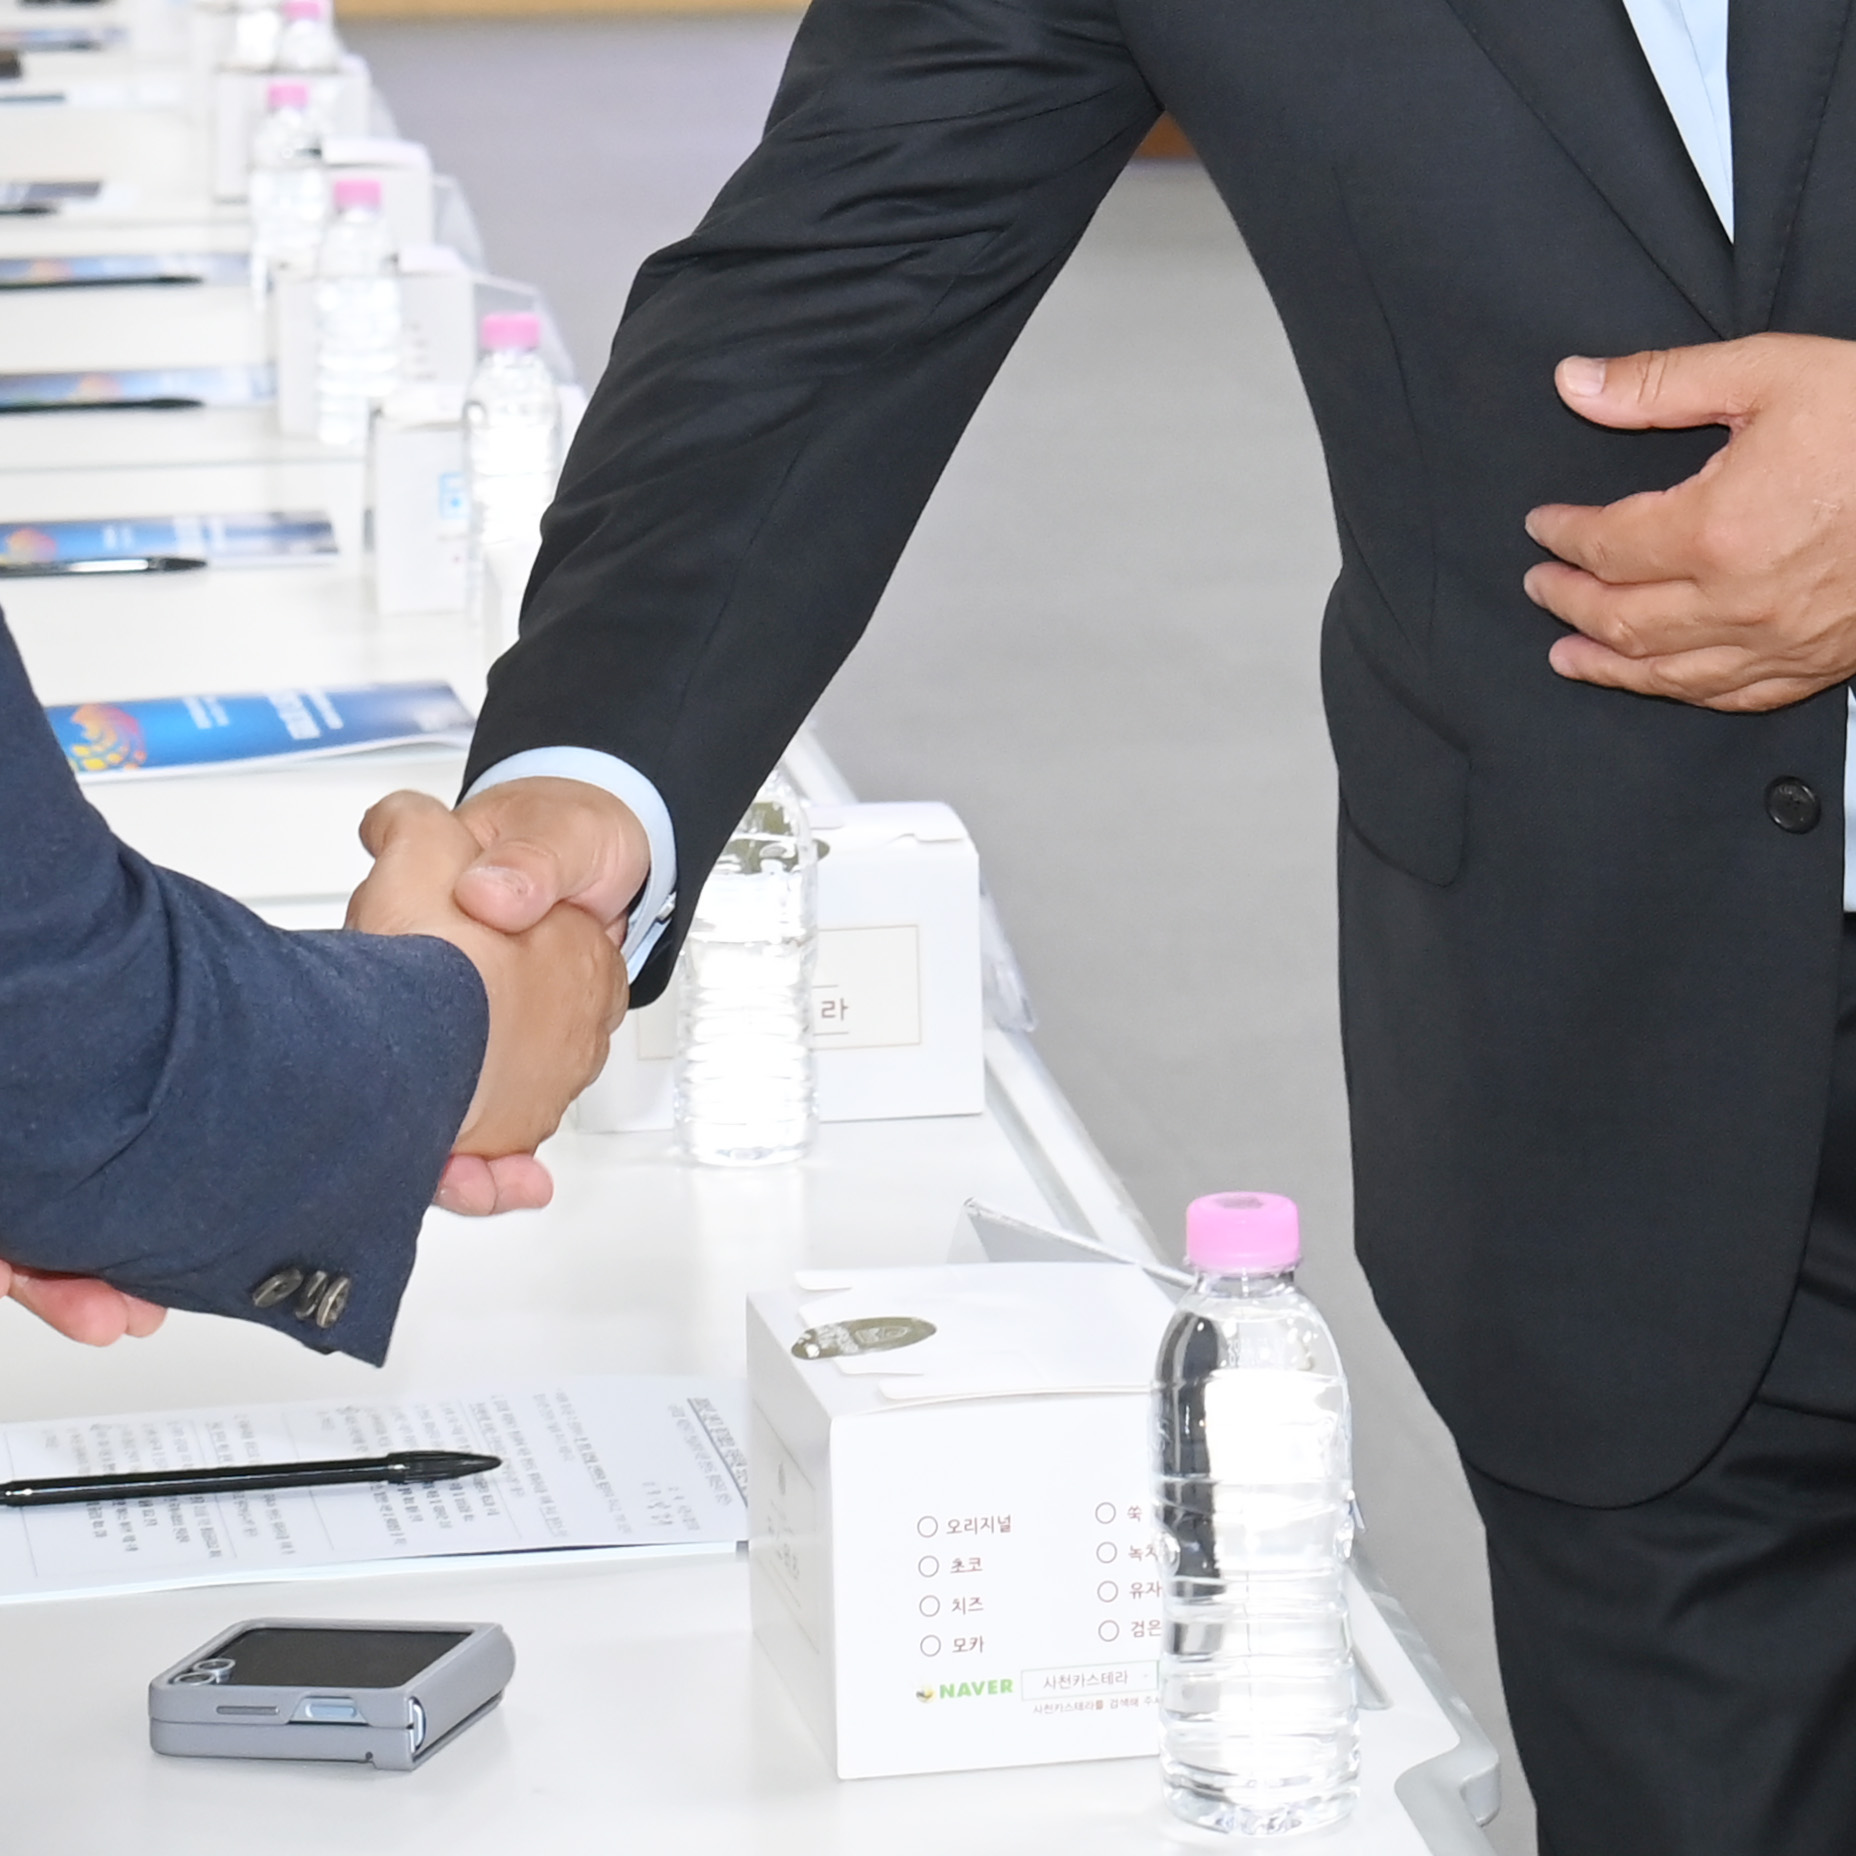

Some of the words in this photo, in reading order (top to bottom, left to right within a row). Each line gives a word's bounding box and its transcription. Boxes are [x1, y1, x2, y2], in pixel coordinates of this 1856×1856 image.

[1127, 1505, 1142, 1522] 쑥
[946, 1514, 1012, 1535] 오리지널
[950, 1556, 983, 1574] 초코
[1130, 1580, 1163, 1600] 유자
[951, 1596, 984, 1615] 치즈
[952, 1636, 984, 1653] 모카
[939, 1678, 1013, 1699] NAVER
[1043, 1670, 1129, 1690] 사천카스테라
[1033, 1699, 1104, 1714] 사천카스테라를
